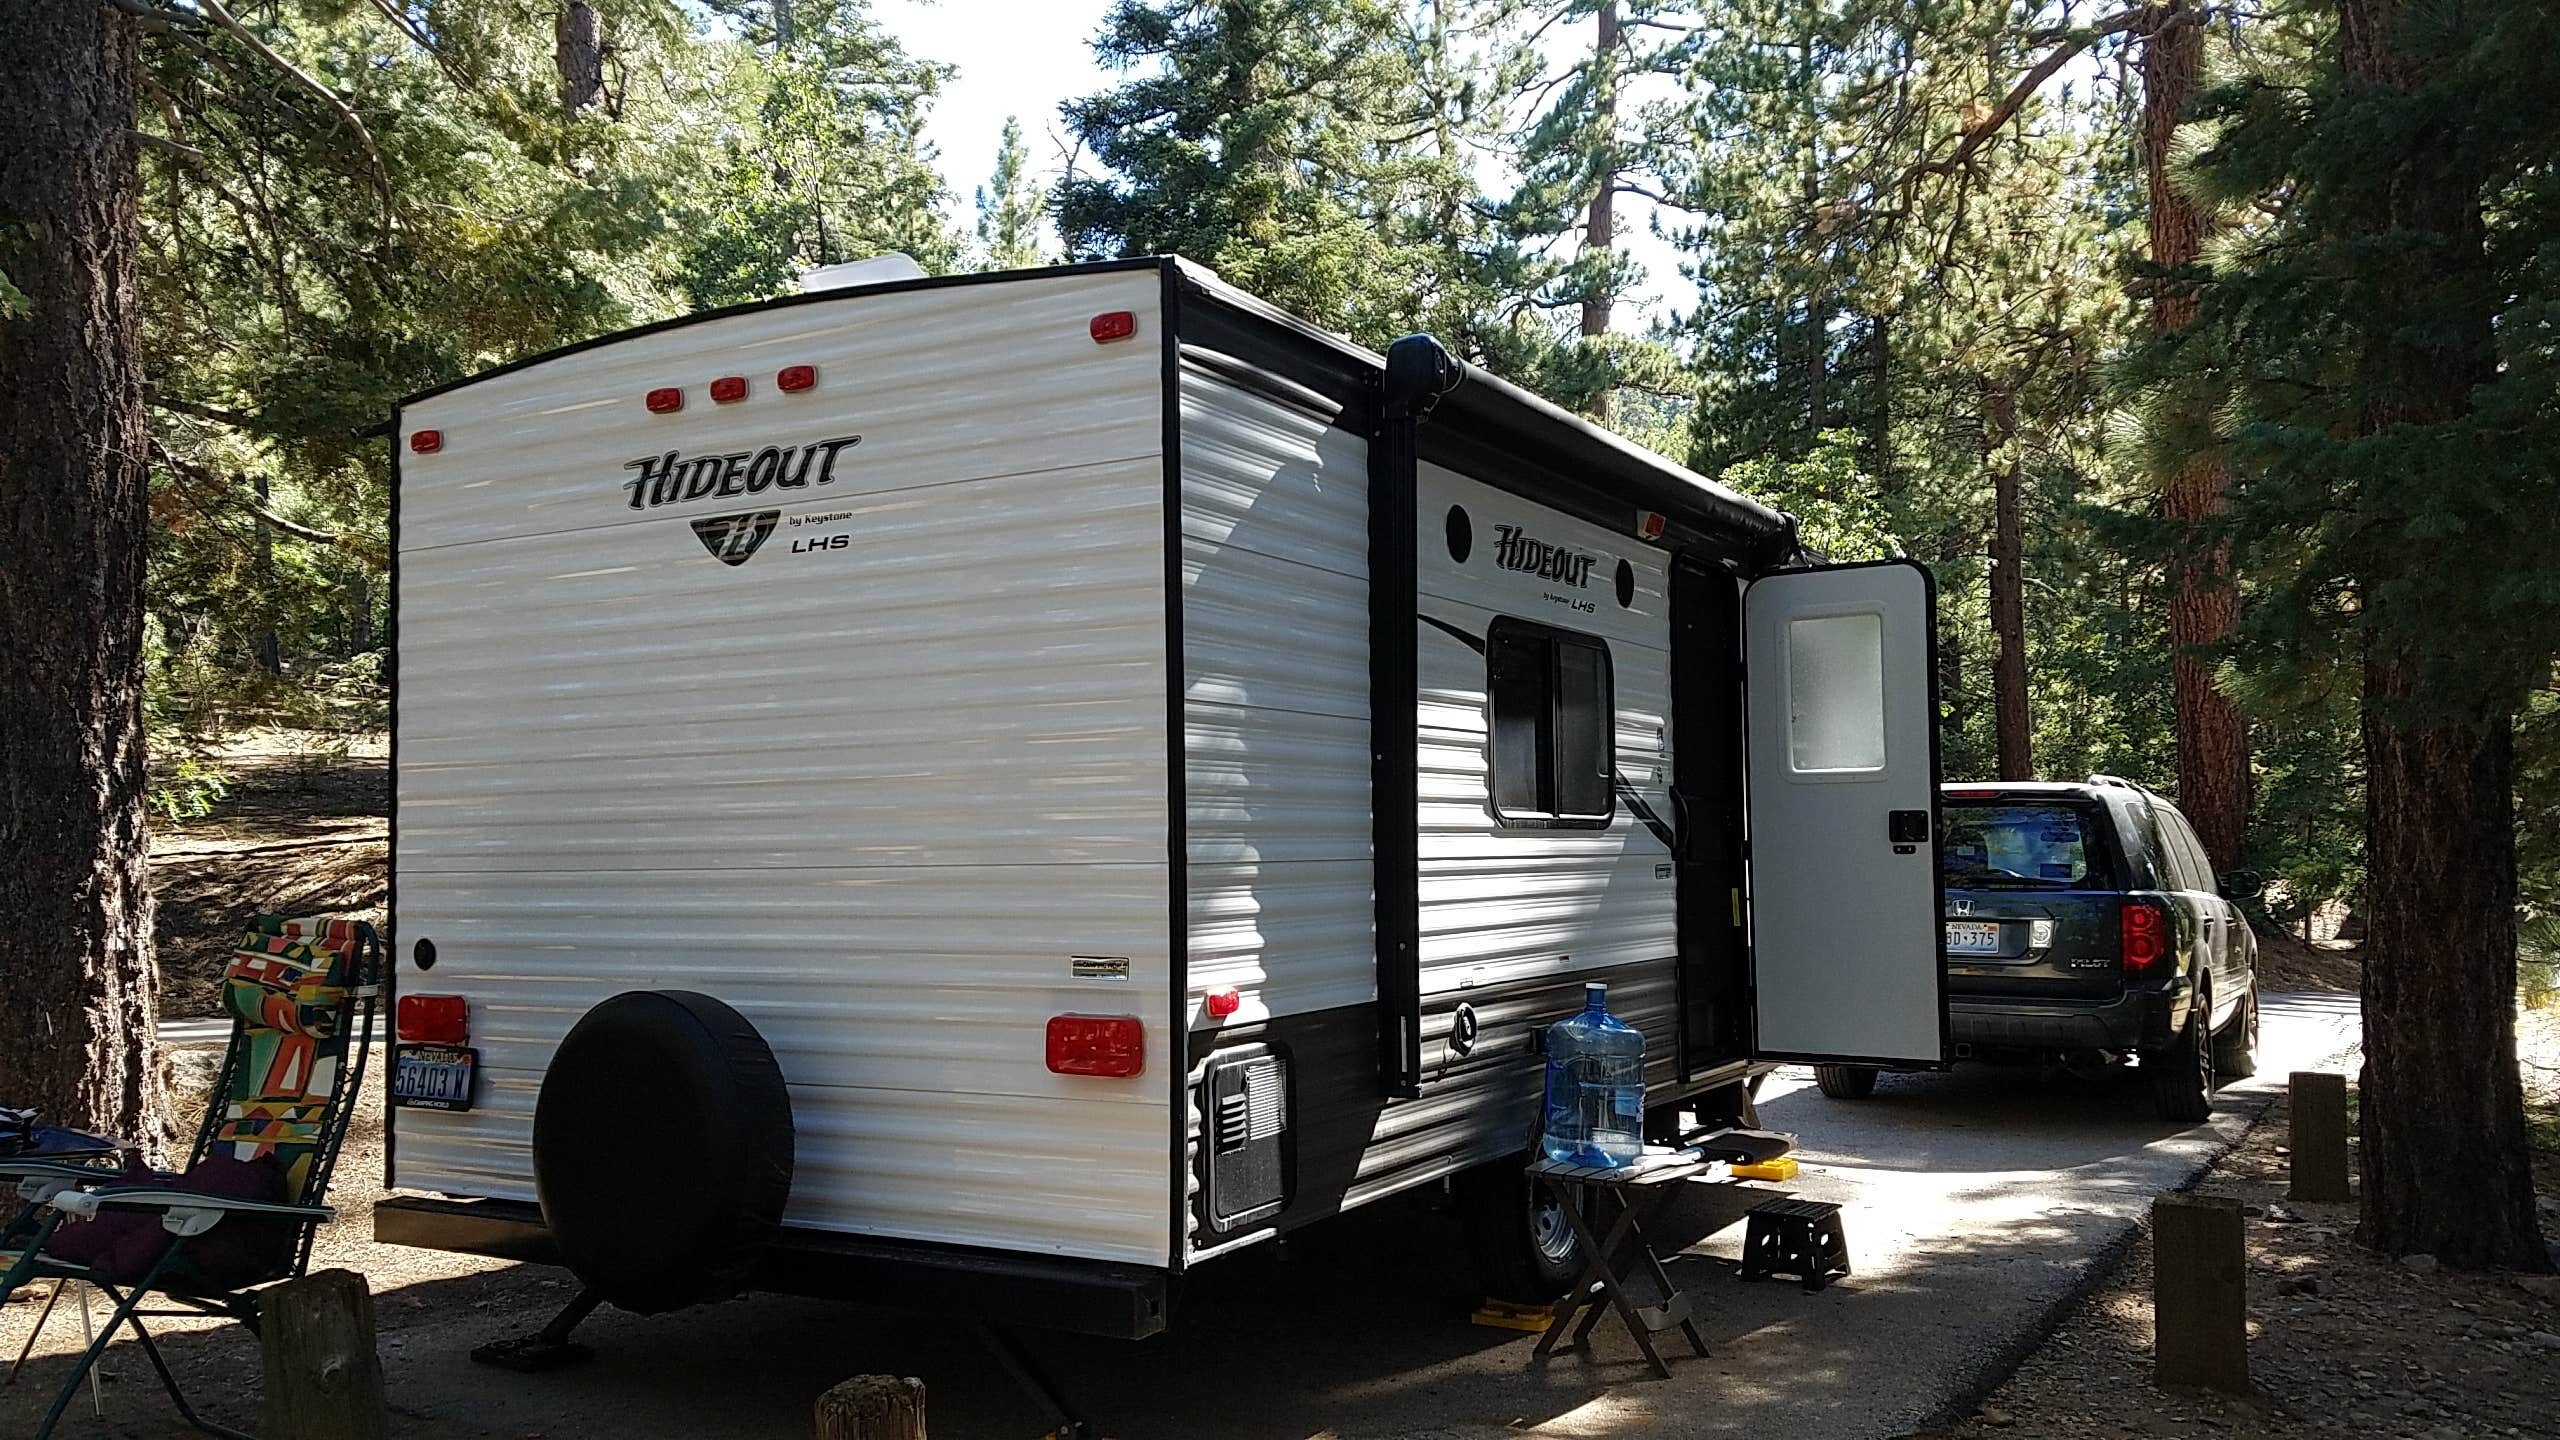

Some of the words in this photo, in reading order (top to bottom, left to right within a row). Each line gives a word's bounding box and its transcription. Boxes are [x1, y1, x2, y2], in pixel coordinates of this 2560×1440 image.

[623, 435, 861, 510] HIDEOUT
[804, 511, 853, 524] Keystone
[791, 534, 850, 553] LHS
[1494, 524, 1597, 588] HIDEOUT
[1570, 598, 1596, 613] LHS
[1951, 923, 1984, 931] NEVADA
[395, 1064, 449, 1098] 56403
